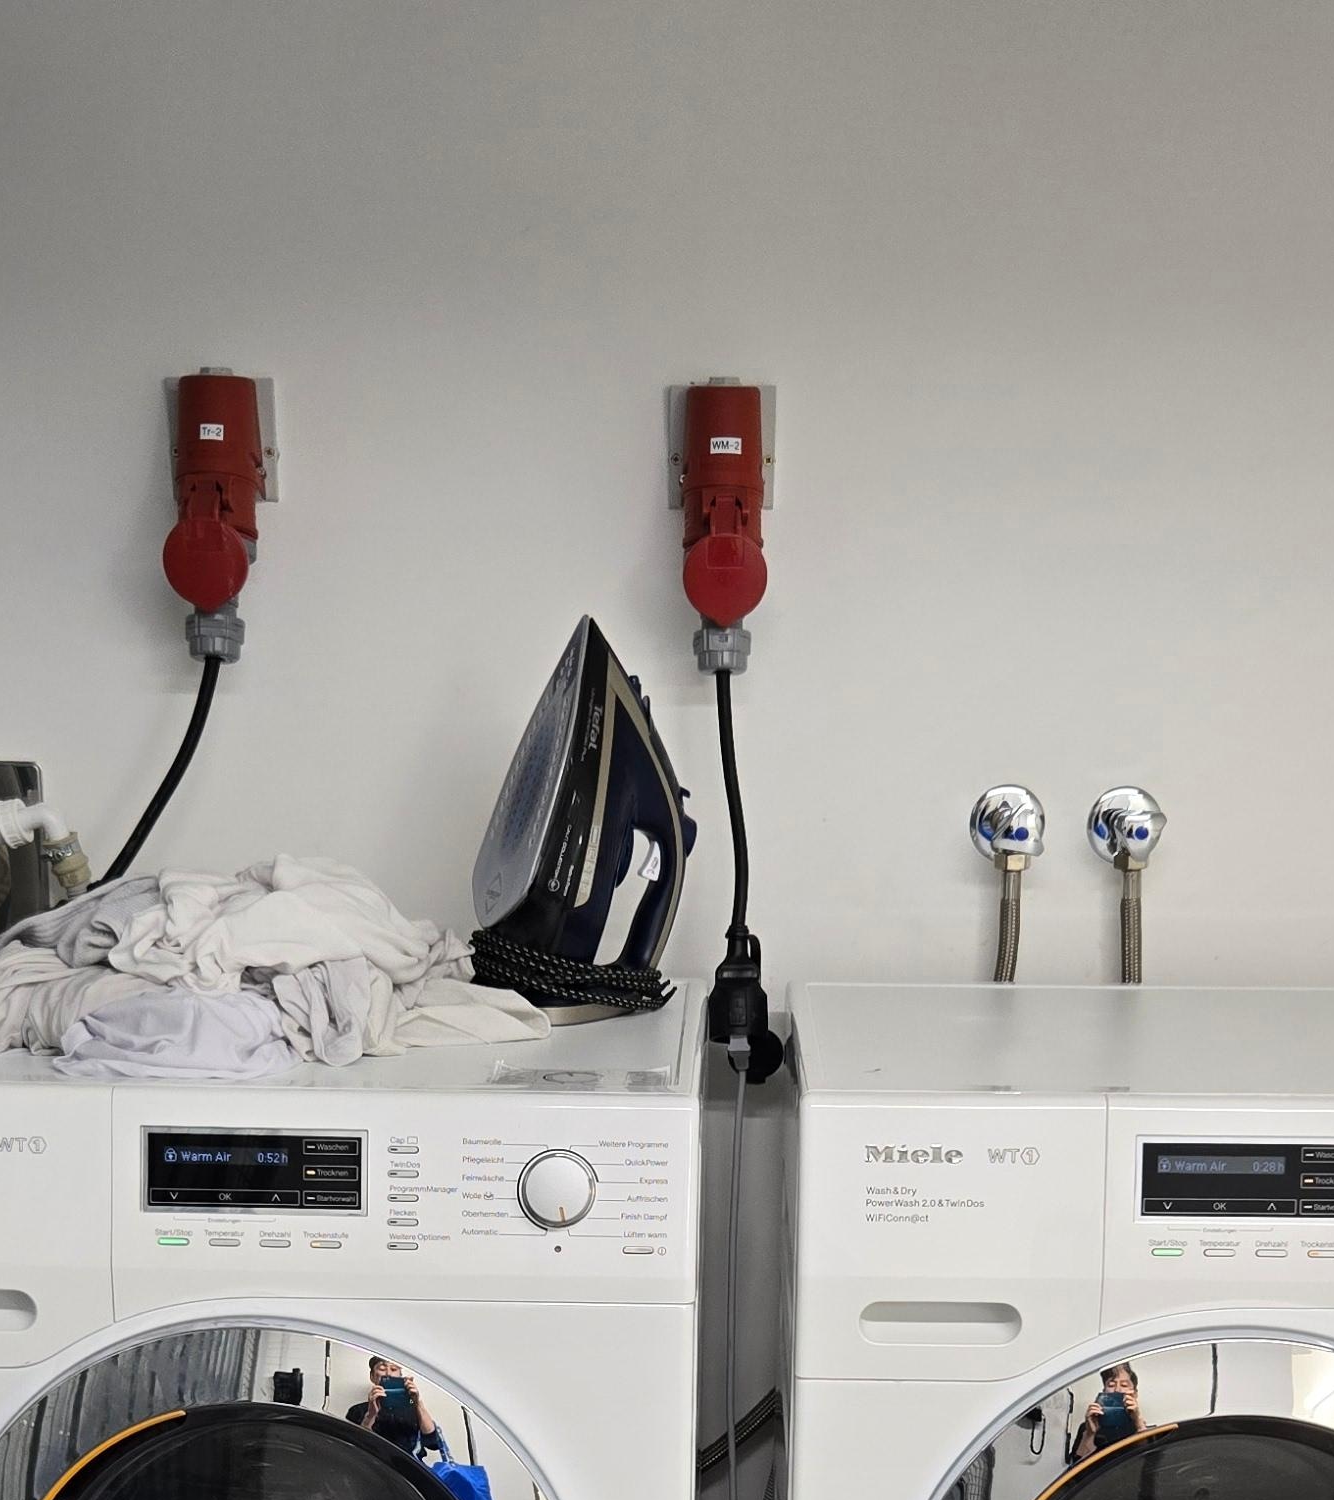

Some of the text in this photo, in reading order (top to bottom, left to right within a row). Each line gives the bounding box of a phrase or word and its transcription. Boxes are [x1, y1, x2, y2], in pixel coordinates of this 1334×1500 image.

[202, 427, 222, 437] Tr-2
[712, 441, 739, 450] WM-2
[588, 704, 604, 750] Tefal
[317, 1143, 349, 1151] Waschen
[598, 1140, 668, 1150] Weitere Programme
[181, 1151, 212, 1162] Warm
[215, 1151, 231, 1162] Air
[257, 1152, 280, 1164] 0:52
[864, 1143, 963, 1164] Miele
[462, 1156, 505, 1164] Pflegeleicht
[625, 1159, 668, 1167] QuickPower
[390, 1161, 420, 1169] TwinDos
[1175, 1161, 1207, 1171] Warm
[1209, 1161, 1227, 1171] Air
[317, 1169, 349, 1177] Trocknen
[639, 1178, 668, 1186] Express
[389, 1185, 457, 1194] ProgrammManager
[219, 1193, 231, 1201] OK
[626, 1195, 668, 1203] Auffrischen
[865, 1199, 920, 1208] PowerWash
[921, 1200, 936, 1208] 2.0
[946, 1199, 985, 1208] TwinDos
[1213, 1202, 1226, 1210] OK
[461, 1210, 509, 1218] Oberhemden
[643, 1213, 667, 1222] Dampf
[865, 1213, 929, 1224] WiFiConn@ct
[155, 1229, 193, 1237] Start/Stop
[204, 1230, 244, 1238] Temperatur
[259, 1230, 291, 1238] Drehzahl
[303, 1231, 349, 1239] Trockenstufe
[461, 1228, 498, 1236] Automatic
[623, 1231, 646, 1239] Lüften
[1149, 1239, 1187, 1248] Start/Stop
[1199, 1240, 1241, 1248] Temperatur
[1255, 1240, 1288, 1248] Drehzahl
